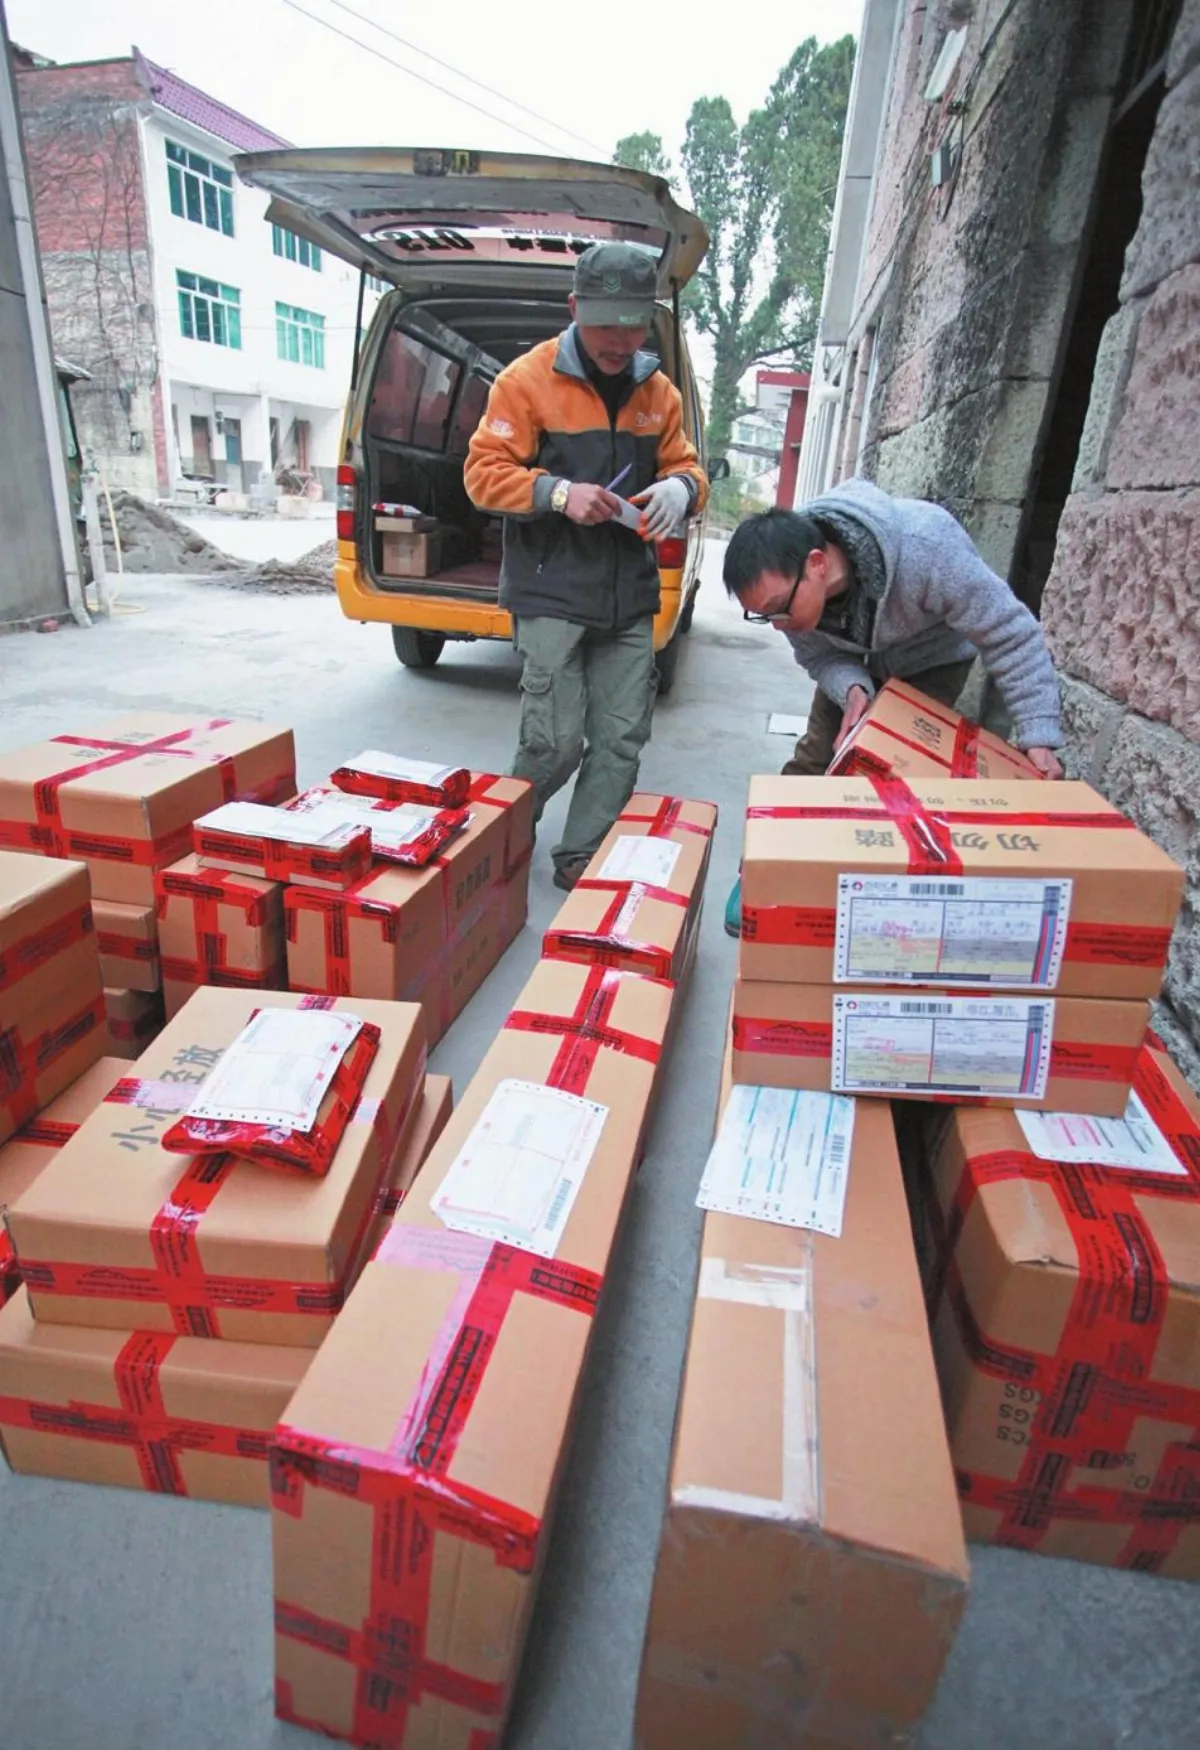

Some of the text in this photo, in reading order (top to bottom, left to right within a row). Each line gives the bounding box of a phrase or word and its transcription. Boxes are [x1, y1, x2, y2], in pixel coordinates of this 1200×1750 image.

[855, 828, 1041, 851] 切勿踏
[1004, 1382, 1041, 1403] GS
[999, 1403, 1032, 1424] GS
[996, 1425, 1030, 1445] CS
